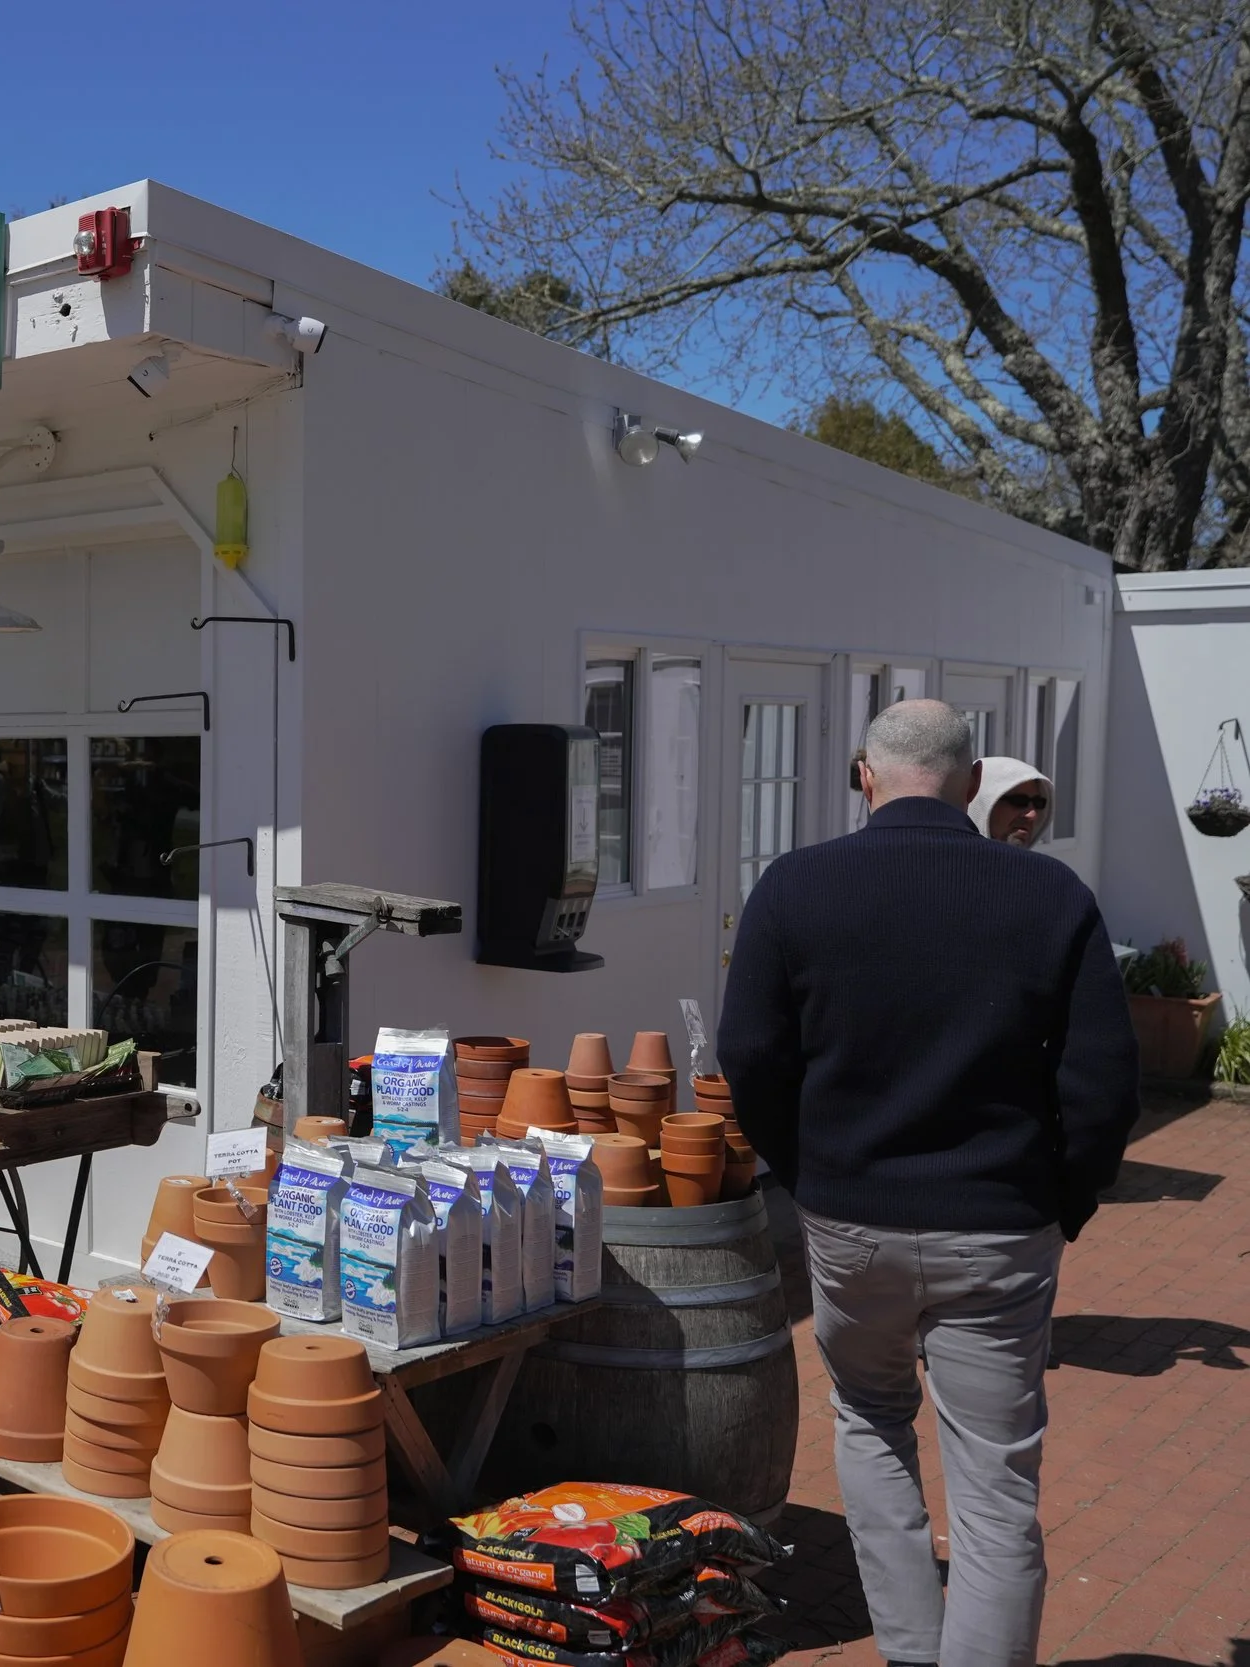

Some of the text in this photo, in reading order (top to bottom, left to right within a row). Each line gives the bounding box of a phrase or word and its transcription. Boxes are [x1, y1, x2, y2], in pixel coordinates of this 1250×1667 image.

[383, 1076, 426, 1087] ORGANIC
[376, 1085, 434, 1096] PLANT FOOD
[278, 1189, 315, 1205] ORGANIC
[270, 1196, 323, 1216] PLANT FOOD
[292, 1216, 315, 1226] CASTINGS
[350, 1207, 389, 1224] ORGANIC
[343, 1216, 394, 1236] PLANT FOOD
[363, 1237, 385, 1247] CASTINGS
[157, 1254, 198, 1269] TERRA COTTA
[166, 1265, 180, 1273] POT
[476, 1544, 535, 1561] BLACK GOLD
[497, 1563, 505, 1572] &
[506, 1565, 548, 1581] Organic
[485, 1591, 544, 1618] BLACK GOLD
[492, 1633, 556, 1661] BLACK GOLD
